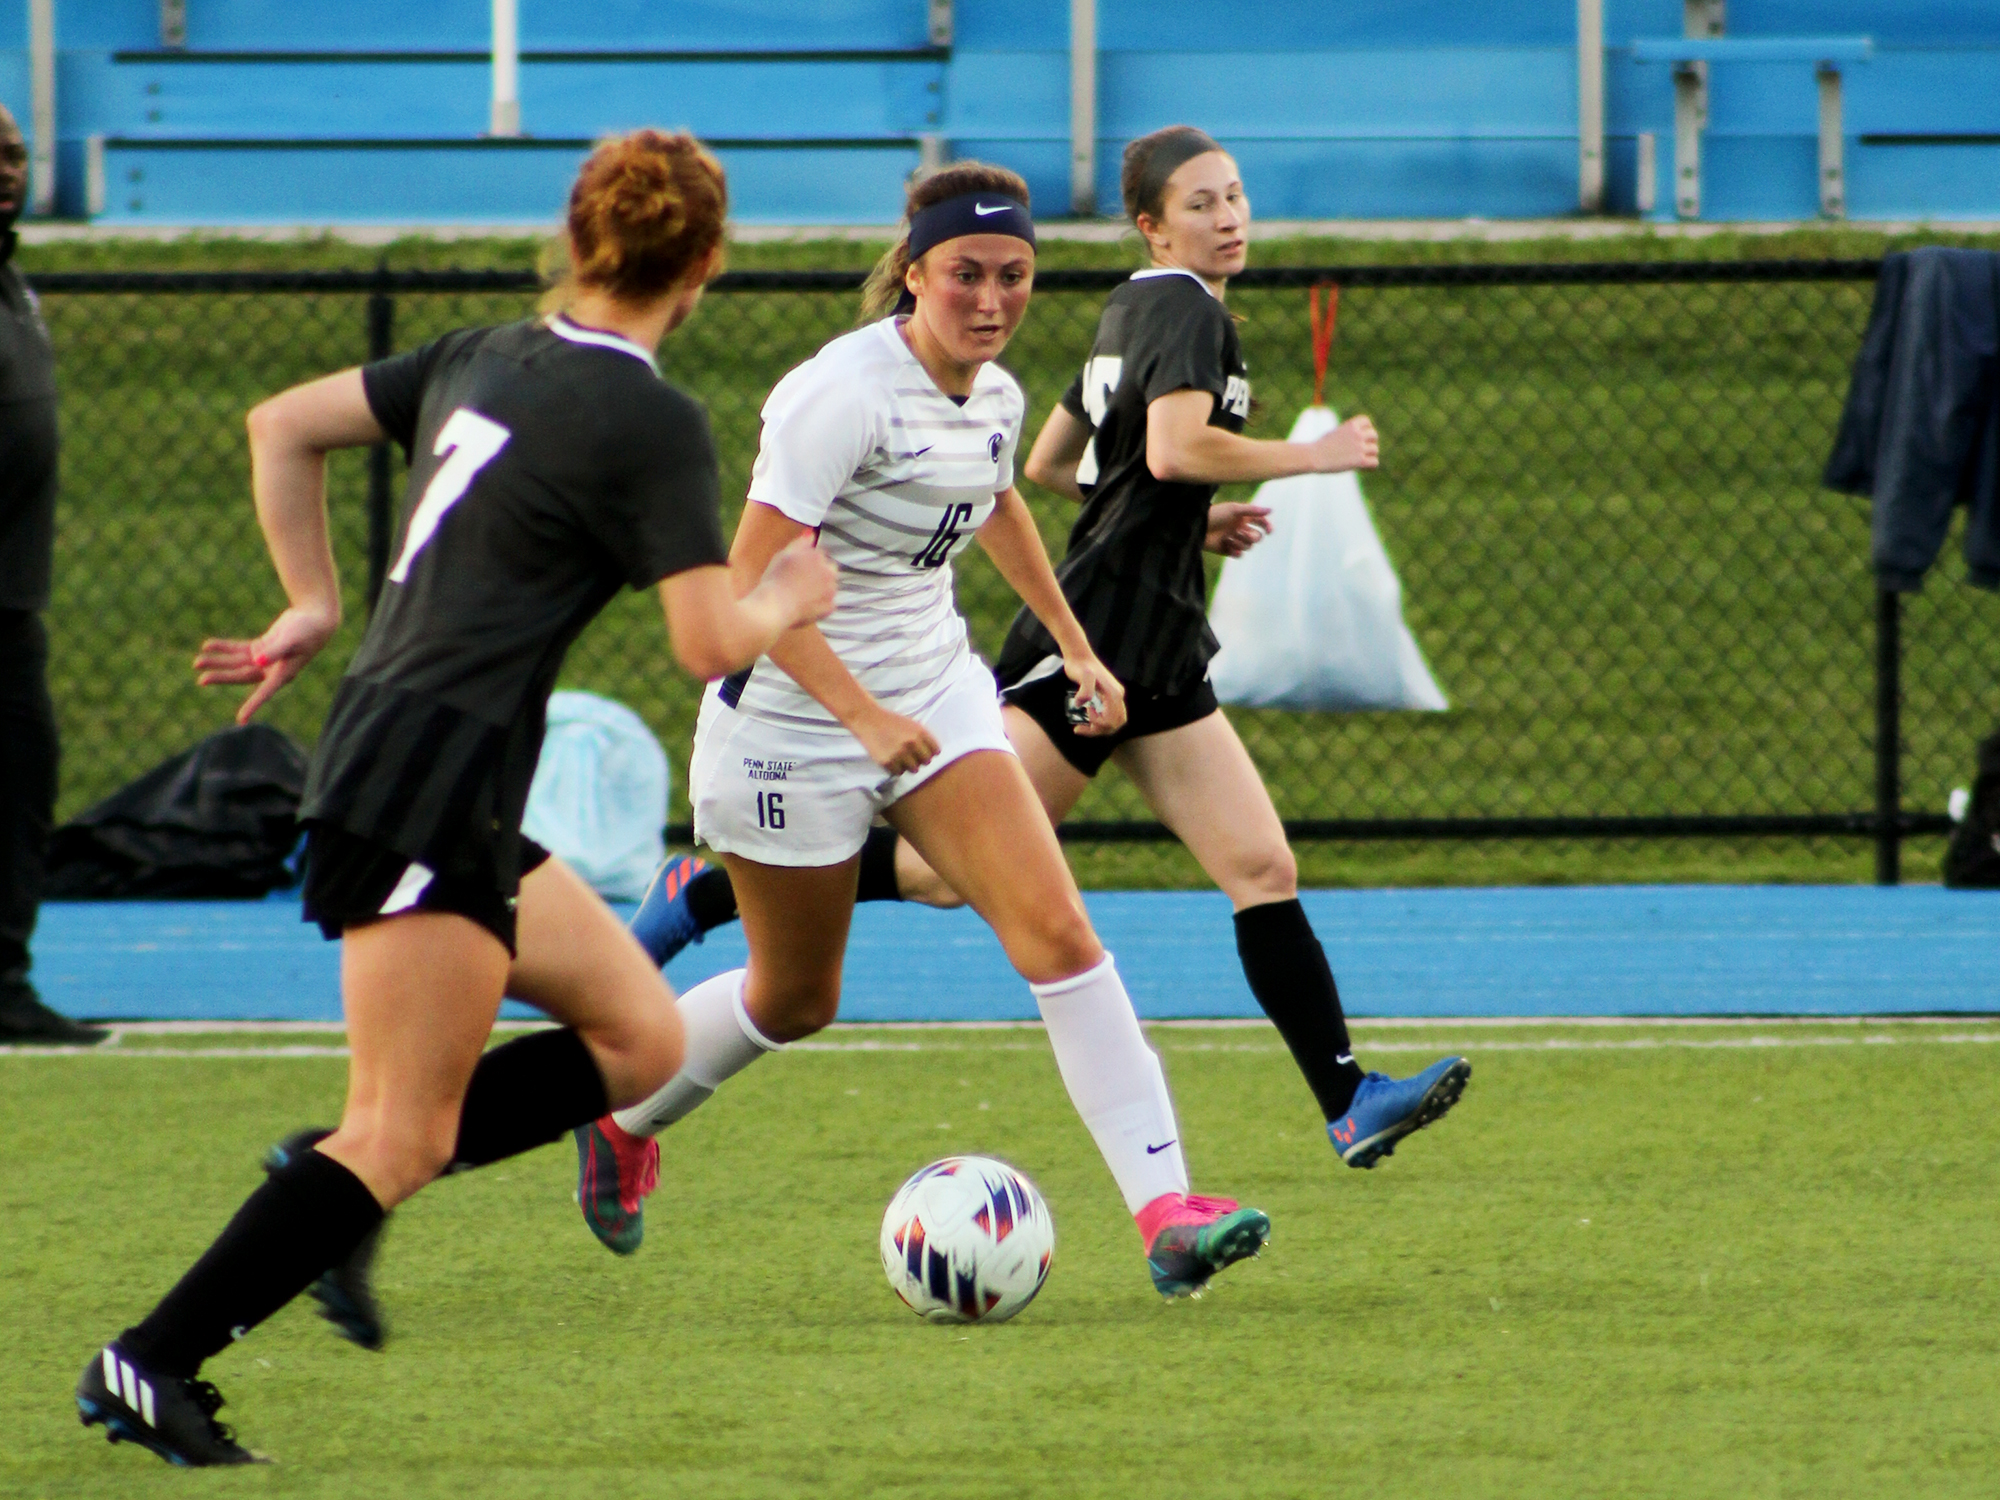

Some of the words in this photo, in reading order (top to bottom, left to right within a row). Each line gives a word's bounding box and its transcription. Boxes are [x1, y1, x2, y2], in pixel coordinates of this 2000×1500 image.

[388, 406, 511, 583] 7
[910, 503, 973, 567] 16
[743, 757, 765, 770] PENN
[767, 760, 793, 771] STATE
[748, 769, 787, 781] ALTOONA
[757, 791, 785, 829] 16
